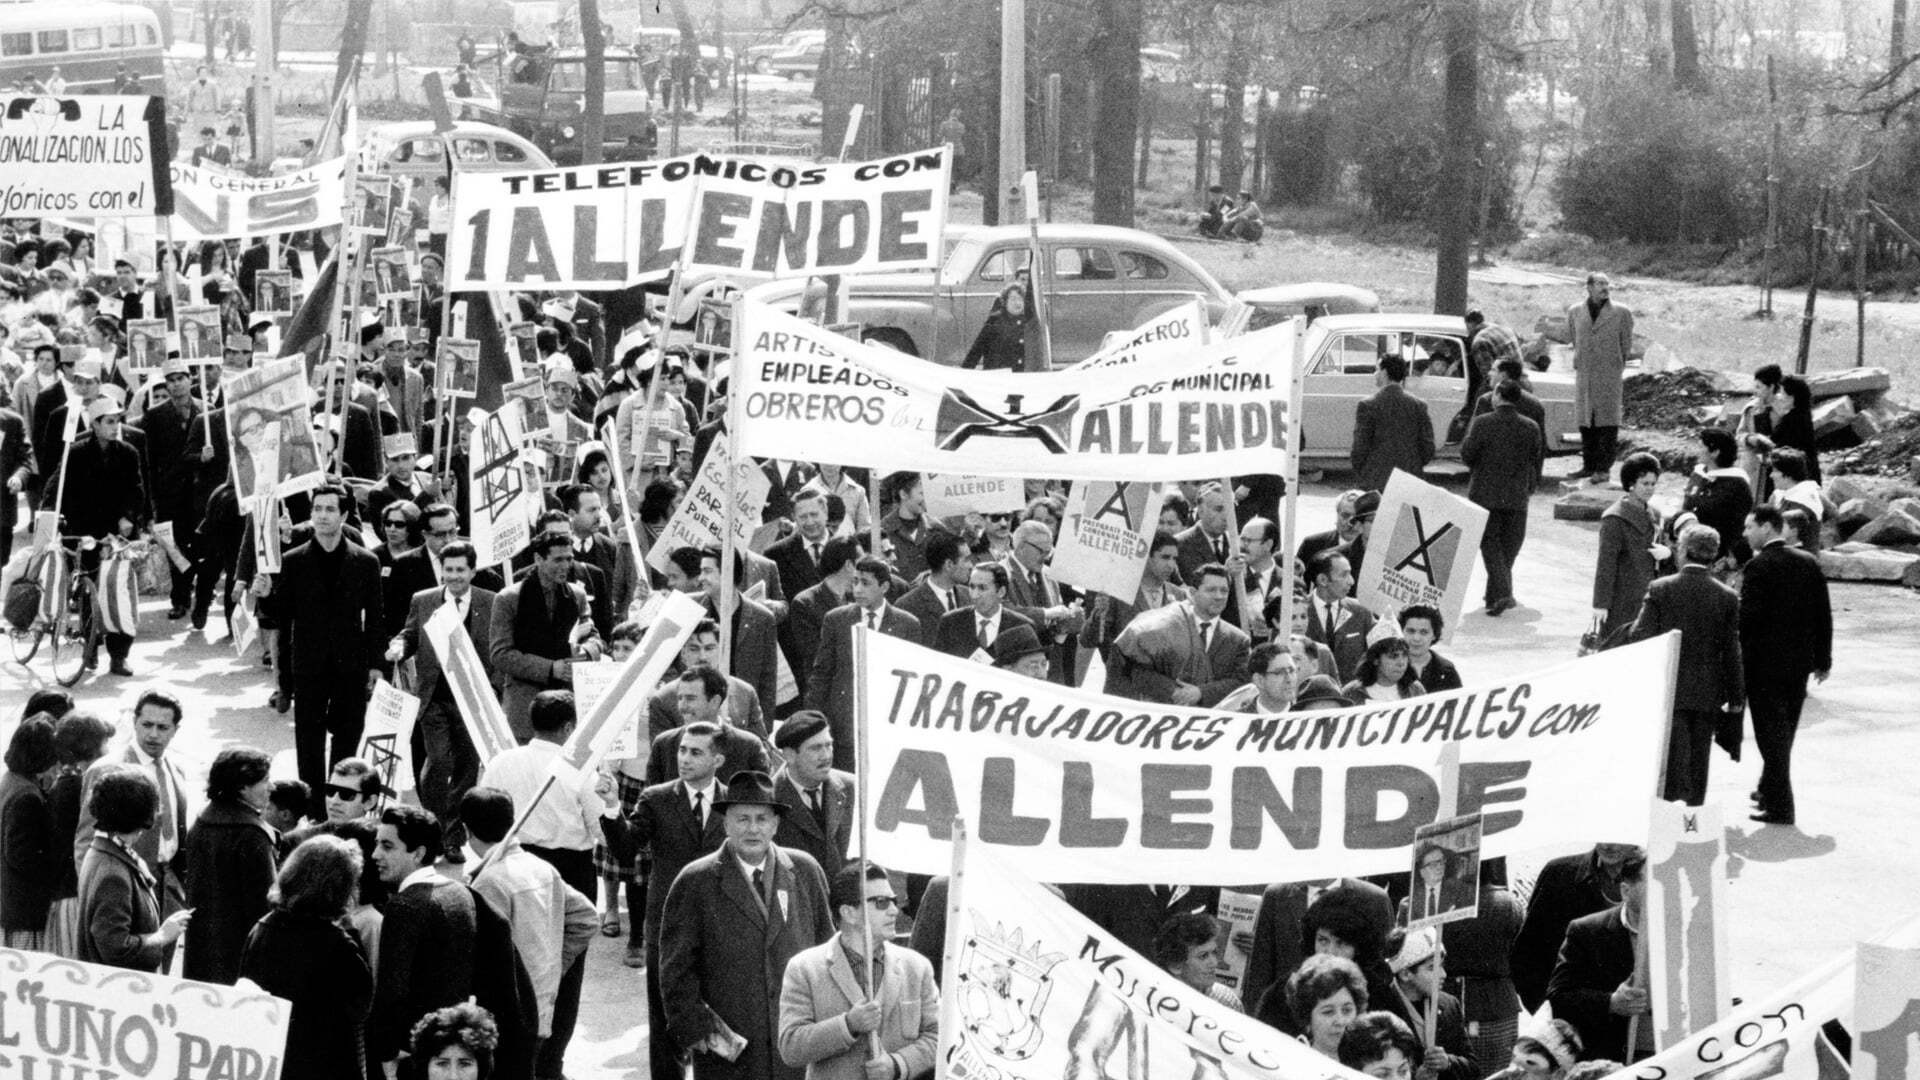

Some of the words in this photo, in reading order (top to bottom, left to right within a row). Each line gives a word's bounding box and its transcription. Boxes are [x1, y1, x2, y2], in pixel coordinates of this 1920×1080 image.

[98, 104, 124, 130] LA
[113, 136, 144, 164] LOS
[502, 154, 826, 195] TELEFONICOS
[854, 152, 943, 182] CON
[89, 190, 122, 210] con
[128, 181, 144, 209] el
[505, 189, 933, 283] ALLENDE
[760, 361, 909, 397] EMPLEADOS
[1171, 373, 1275, 392] MUNICIPAL
[746, 392, 886, 426] OBREROS
[1078, 399, 1288, 455] ALLENDE
[944, 480, 1006, 497] ALLENDE
[1078, 533, 1135, 560] ALLENDE
[888, 668, 1234, 751] TRABAJADORES
[1236, 683, 1531, 753] MUNICIPALES
[1529, 703, 1602, 738] con
[874, 748, 1532, 850] ALLENDE
[1697, 1003, 1806, 1063] con
